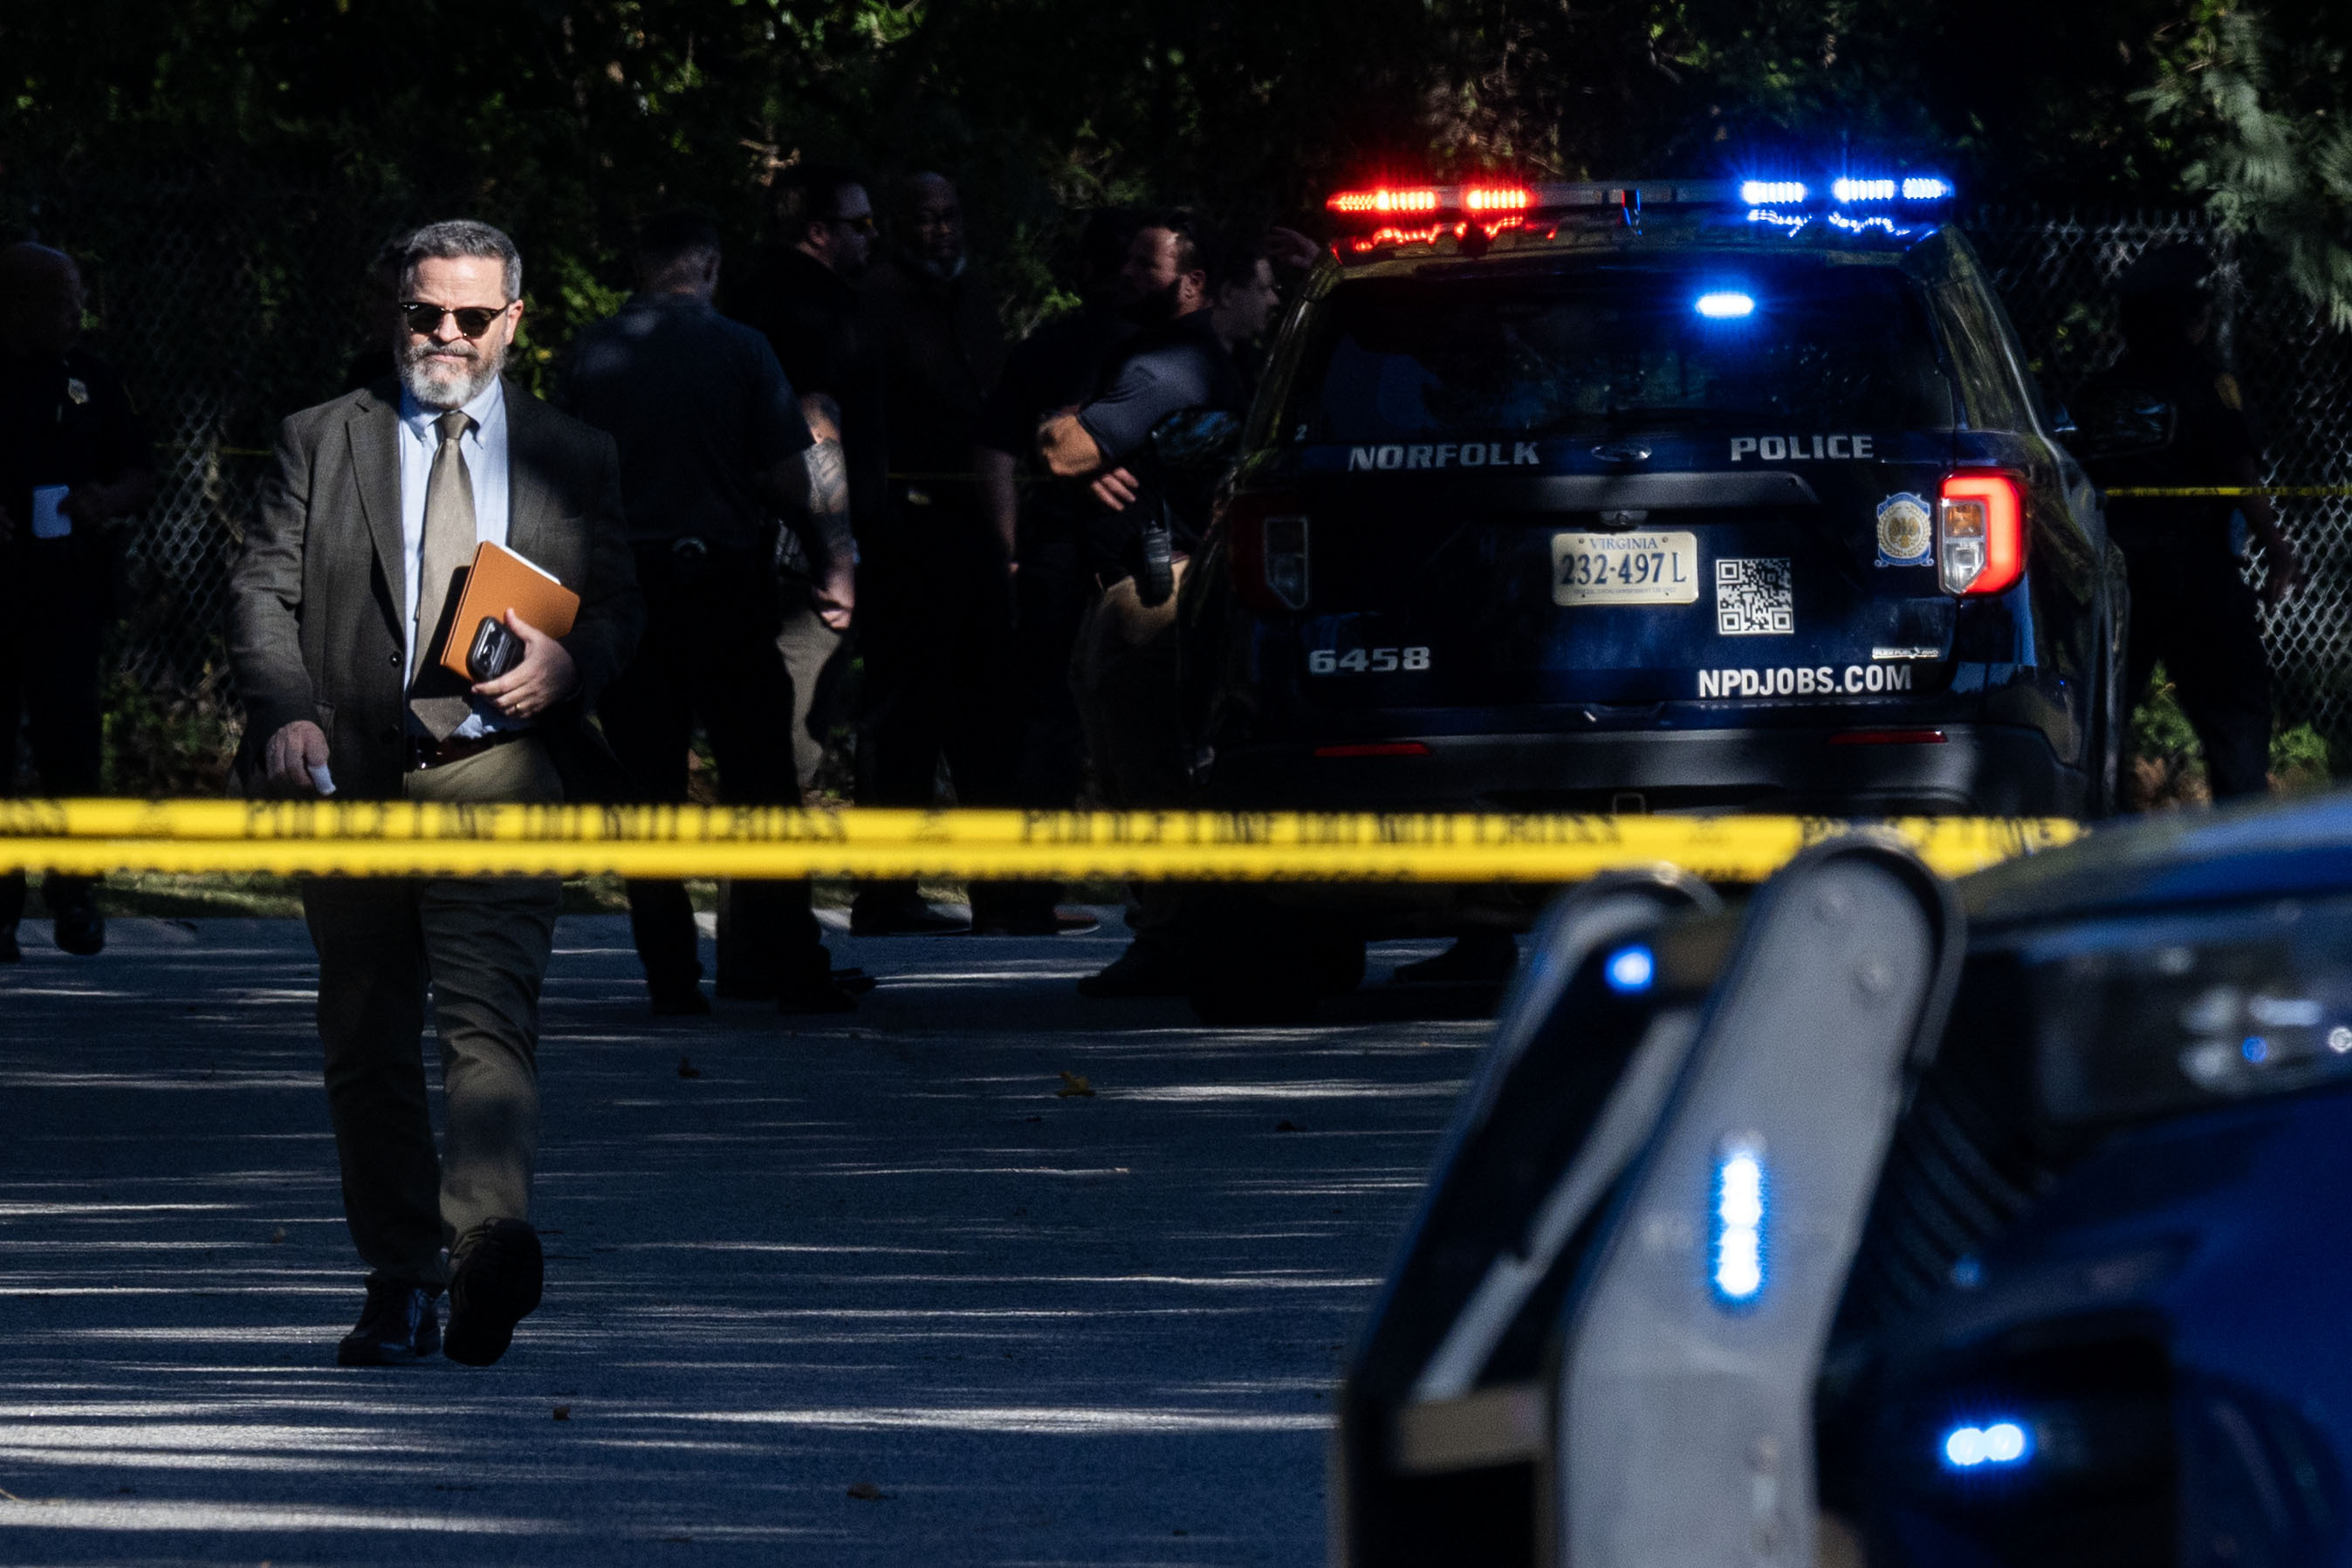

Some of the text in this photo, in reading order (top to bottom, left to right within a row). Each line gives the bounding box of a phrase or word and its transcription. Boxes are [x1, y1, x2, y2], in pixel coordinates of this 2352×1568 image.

[1348, 435, 1875, 472] NORFOLK POLICE
[1589, 537, 1659, 550] VIRGINIA
[1309, 647, 1430, 674] 6458
[1697, 665, 1913, 697] NPDJOBS.COM
